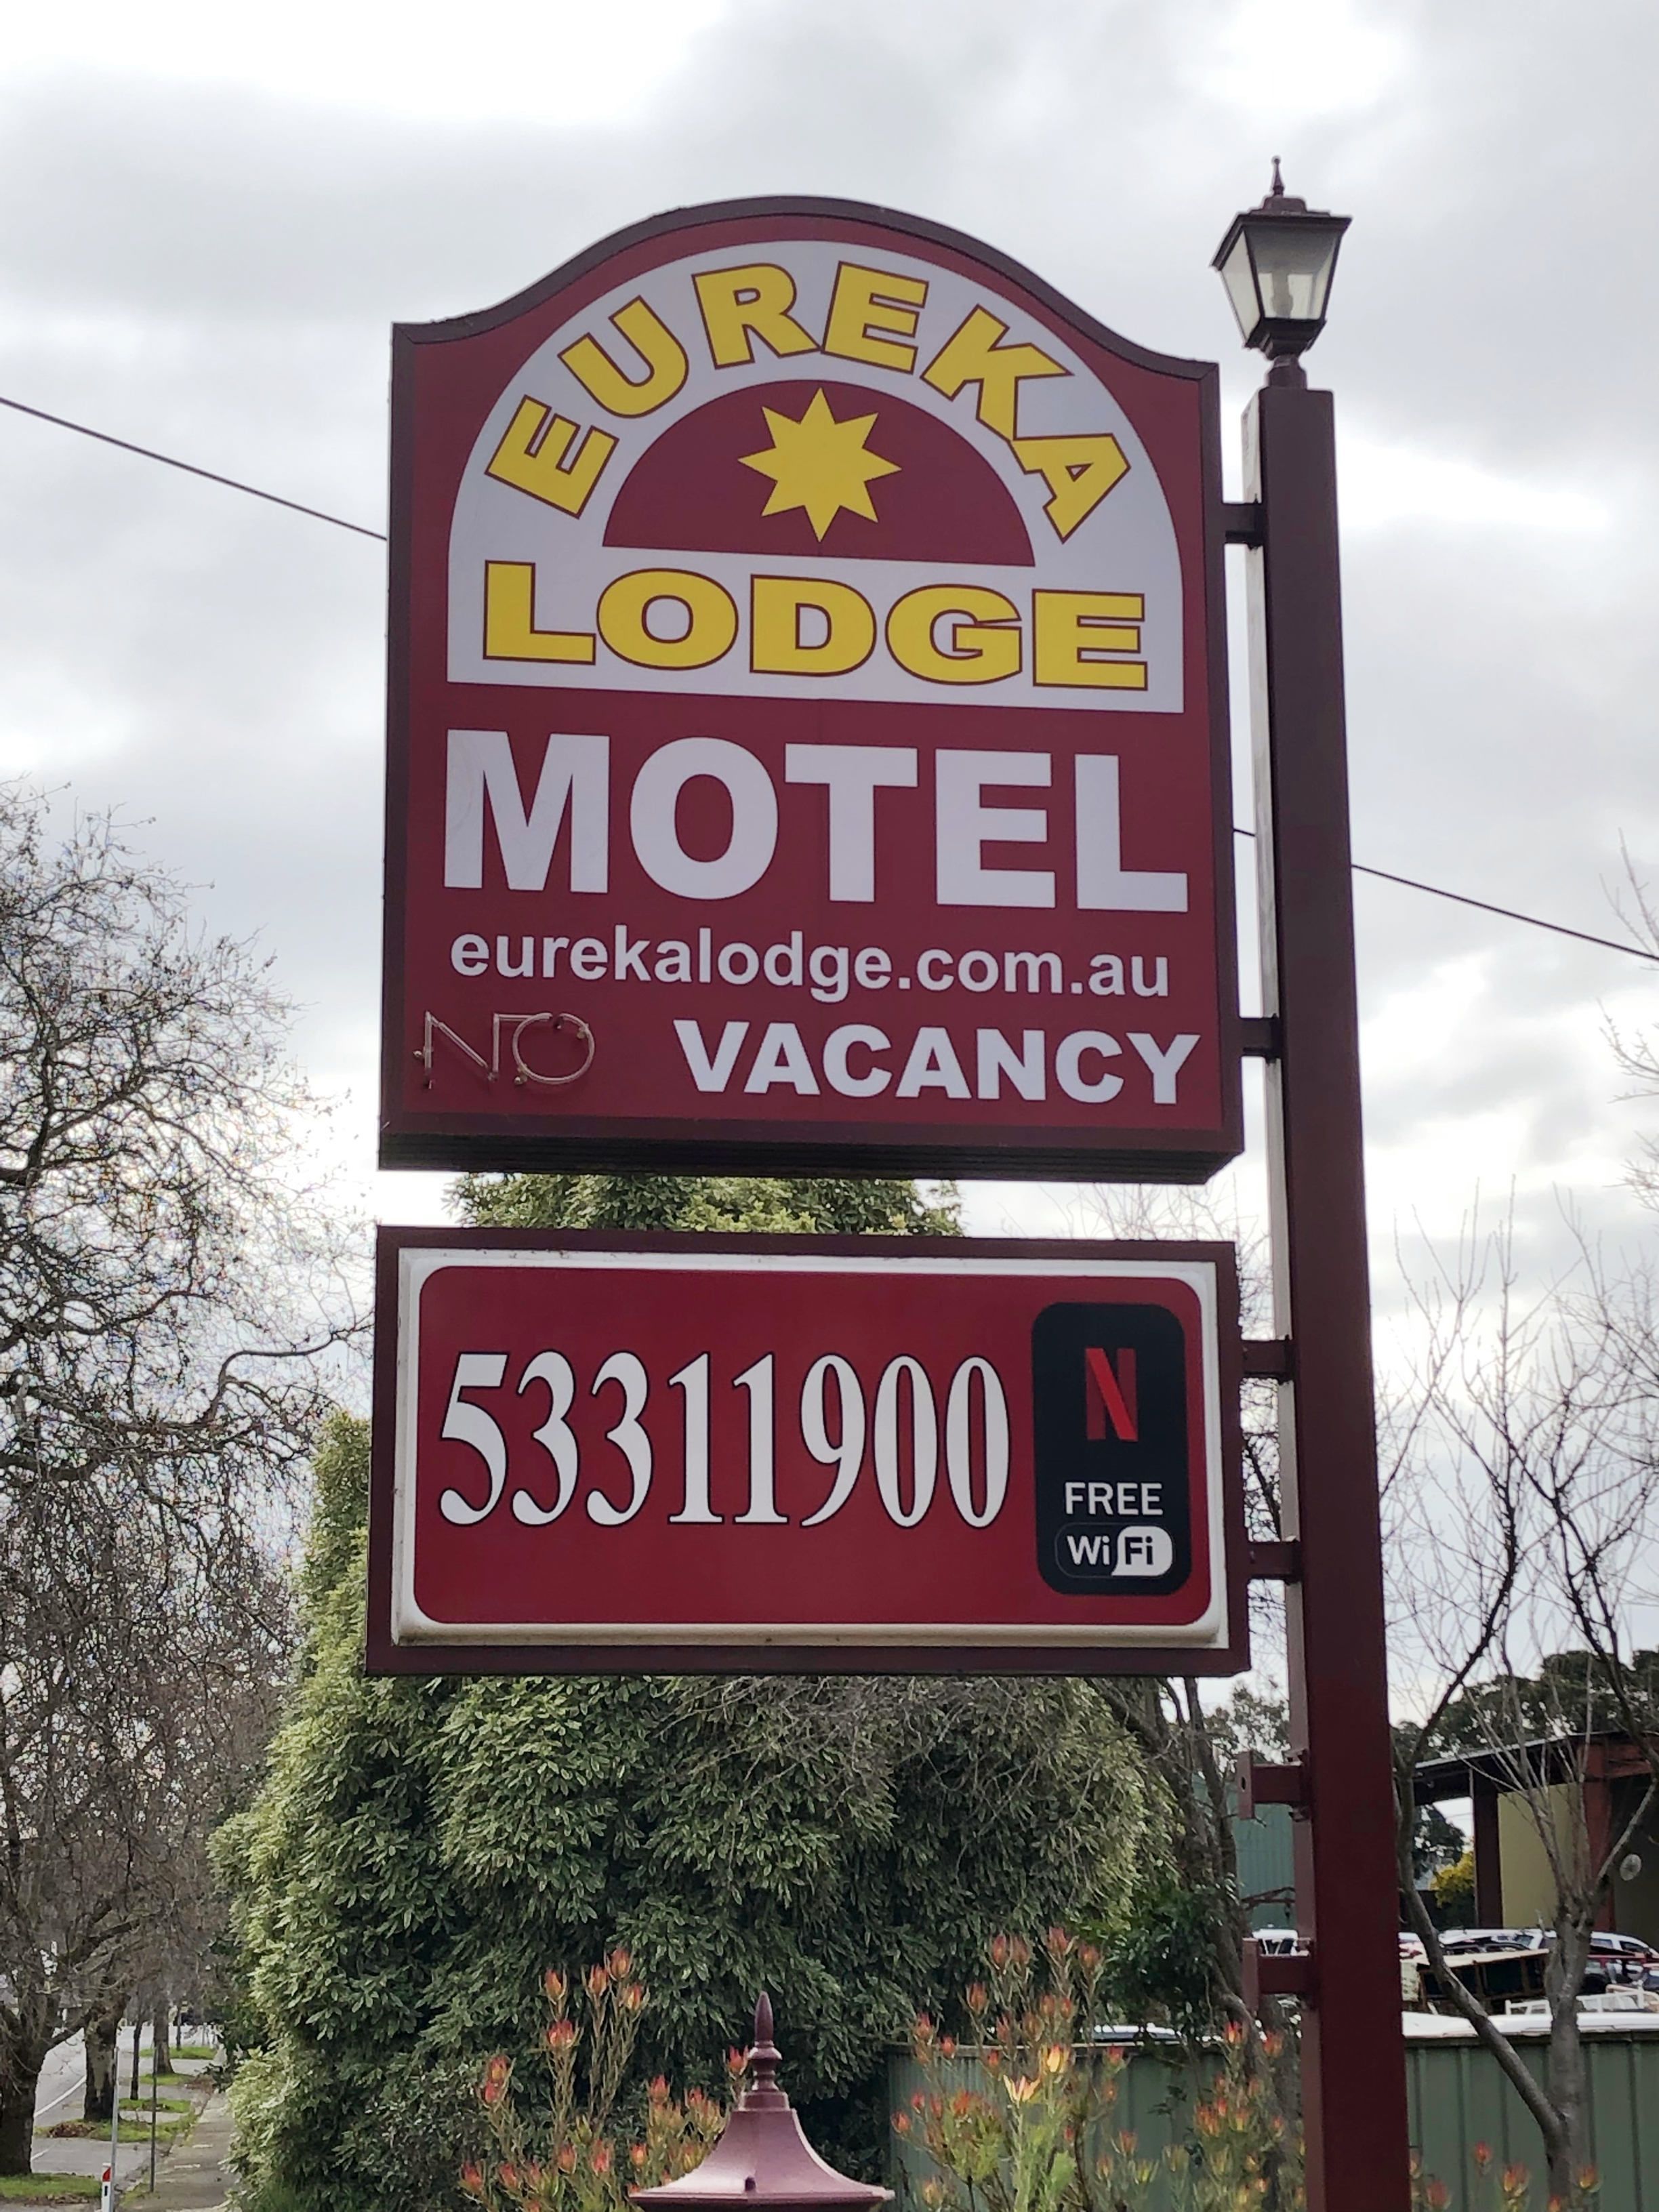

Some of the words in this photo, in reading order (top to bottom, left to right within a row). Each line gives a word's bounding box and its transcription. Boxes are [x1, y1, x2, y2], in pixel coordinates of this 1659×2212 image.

[484, 260, 1130, 544] EUREKA
[483, 560, 1148, 691] LODGE
[443, 729, 1189, 914] MOTEL
[449, 924, 1170, 1003] eurekalodge.com.au
[419, 1010, 595, 1086] NO
[673, 1019, 1202, 1105] VACANCY
[439, 1351, 1010, 1529] 53311900
[1064, 1481, 1164, 1516] FREE
